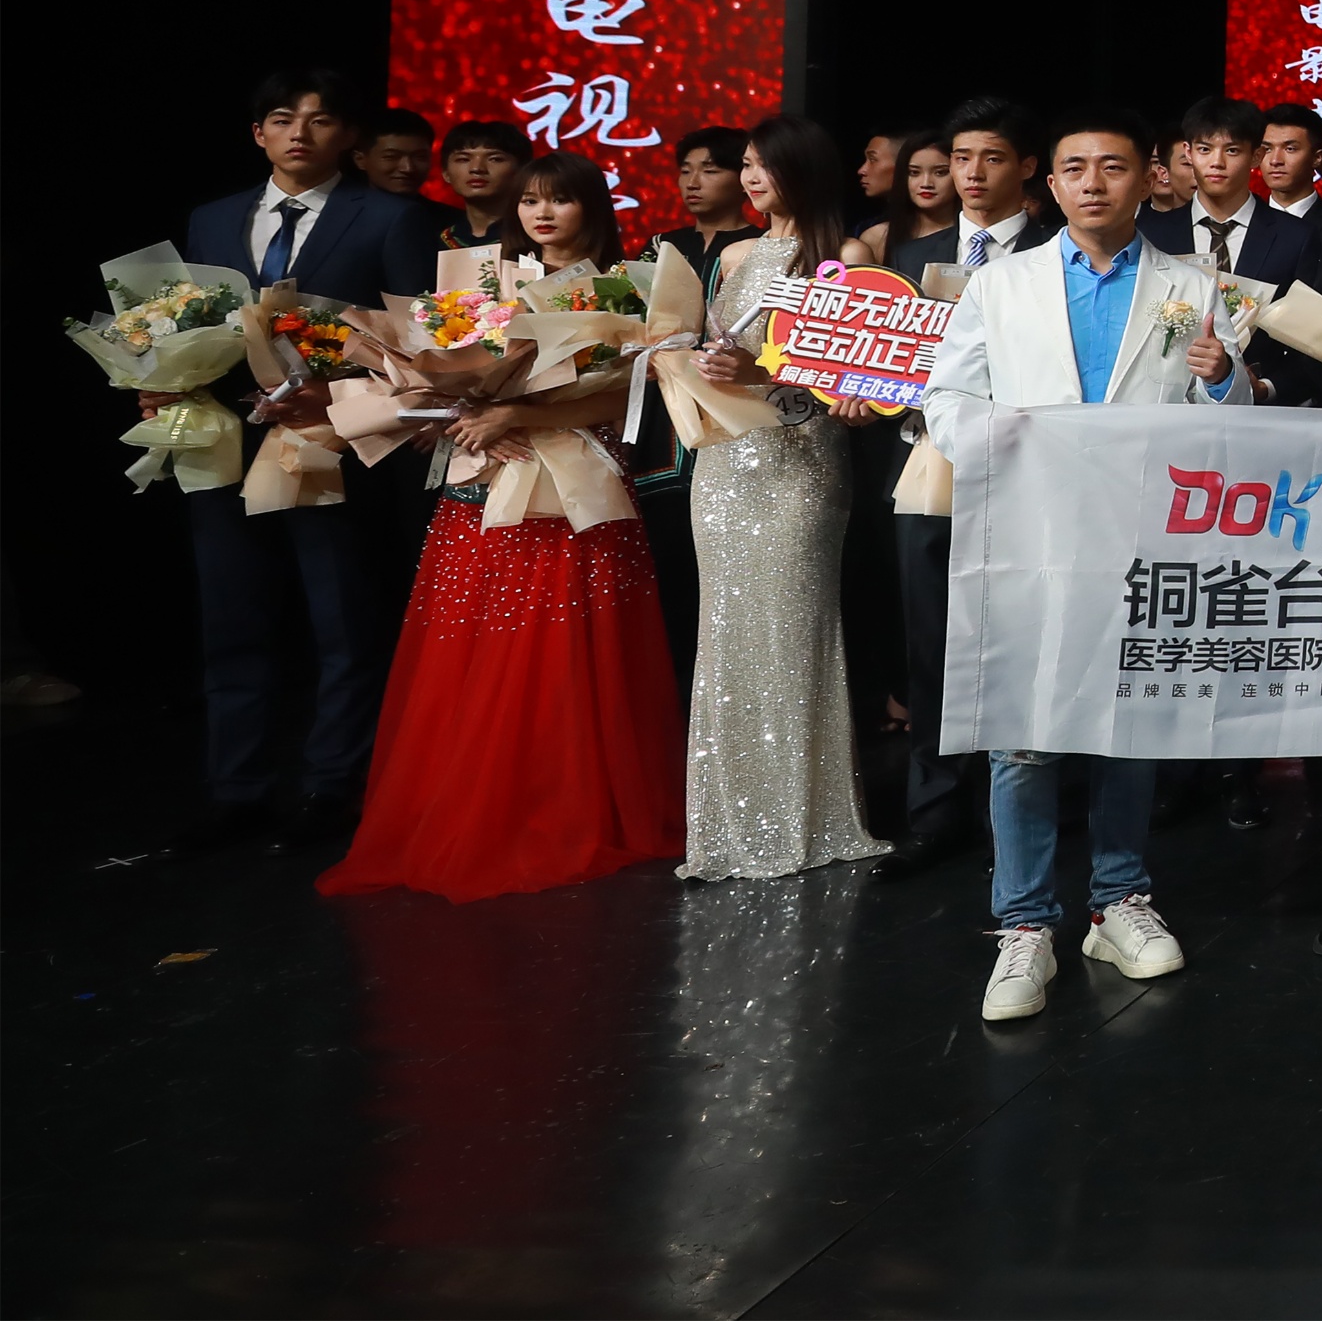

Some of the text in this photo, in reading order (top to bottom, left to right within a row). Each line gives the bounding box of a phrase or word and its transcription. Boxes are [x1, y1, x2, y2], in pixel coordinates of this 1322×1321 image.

[777, 365, 838, 389] 铜雀台
[838, 373, 920, 405] 运动女神
[776, 393, 808, 416] 45
[1116, 682, 1214, 699] 品牌医美
